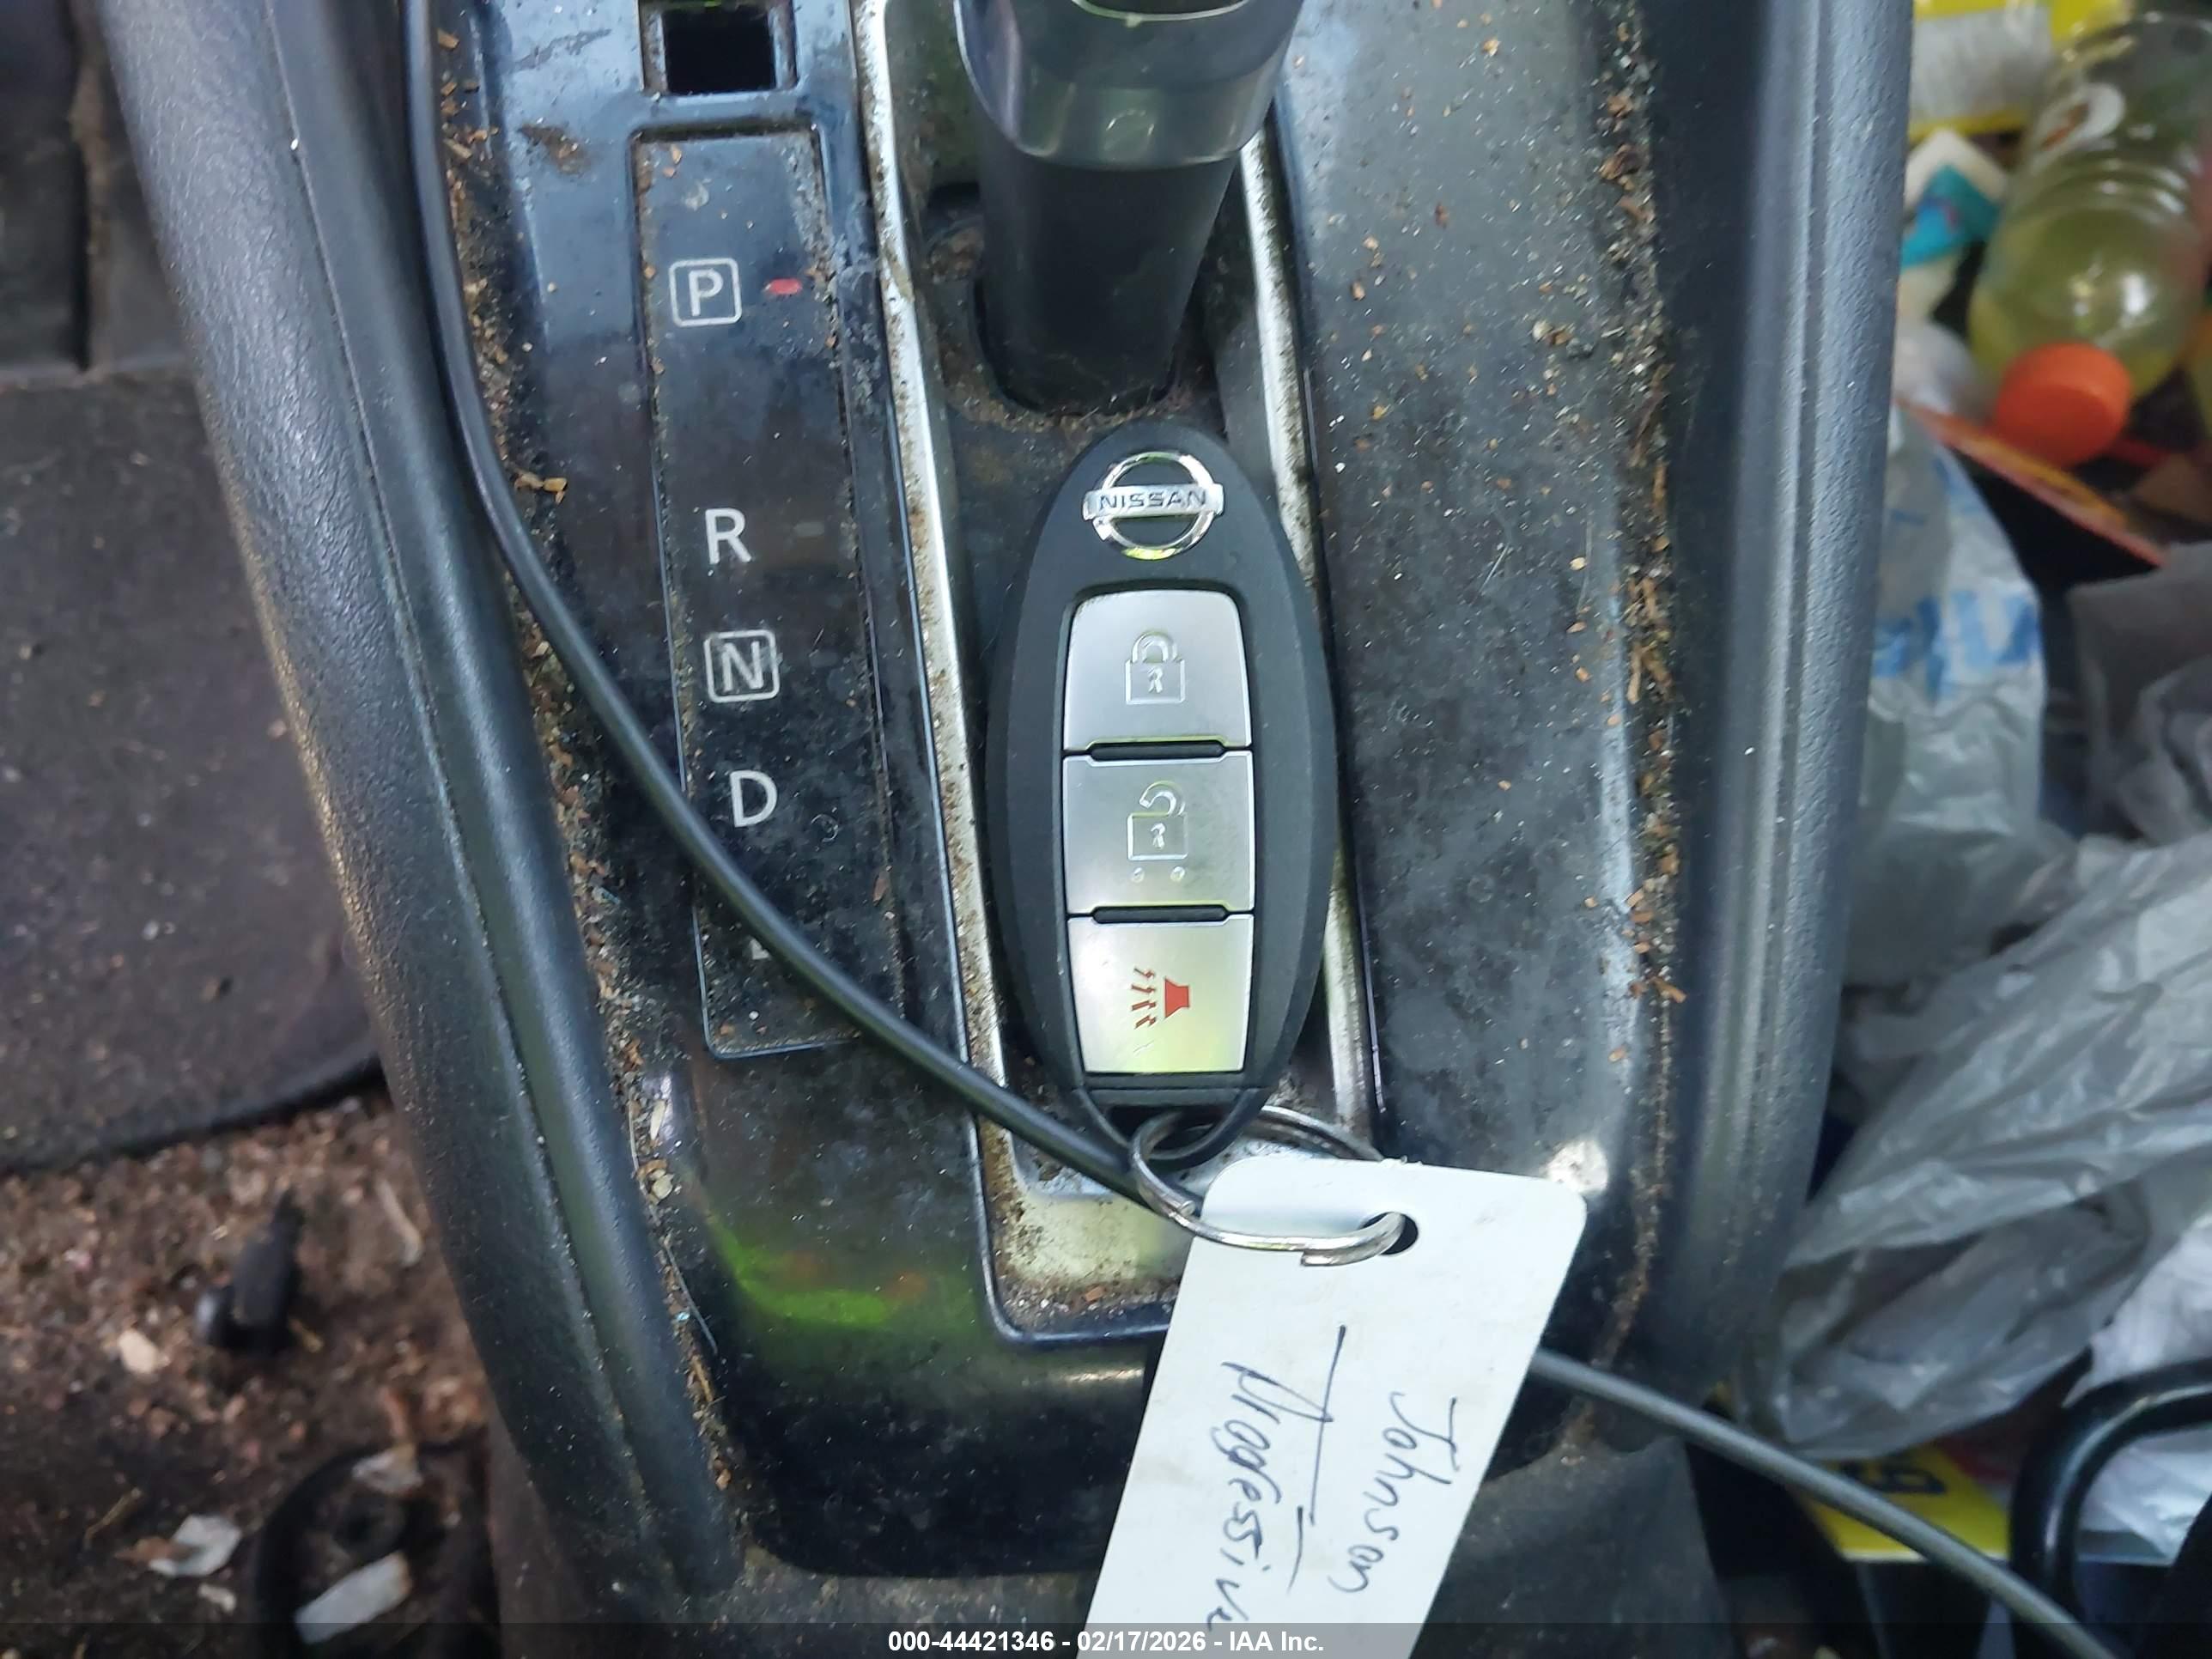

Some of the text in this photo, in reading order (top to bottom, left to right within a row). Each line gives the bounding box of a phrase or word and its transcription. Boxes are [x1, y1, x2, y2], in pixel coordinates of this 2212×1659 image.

[688, 268, 724, 317] P
[1098, 489, 1207, 511] NISSAN
[705, 507, 751, 564] R
[721, 639, 765, 691] N
[729, 769, 778, 828] D
[1328, 1390, 1460, 1592] Johnson
